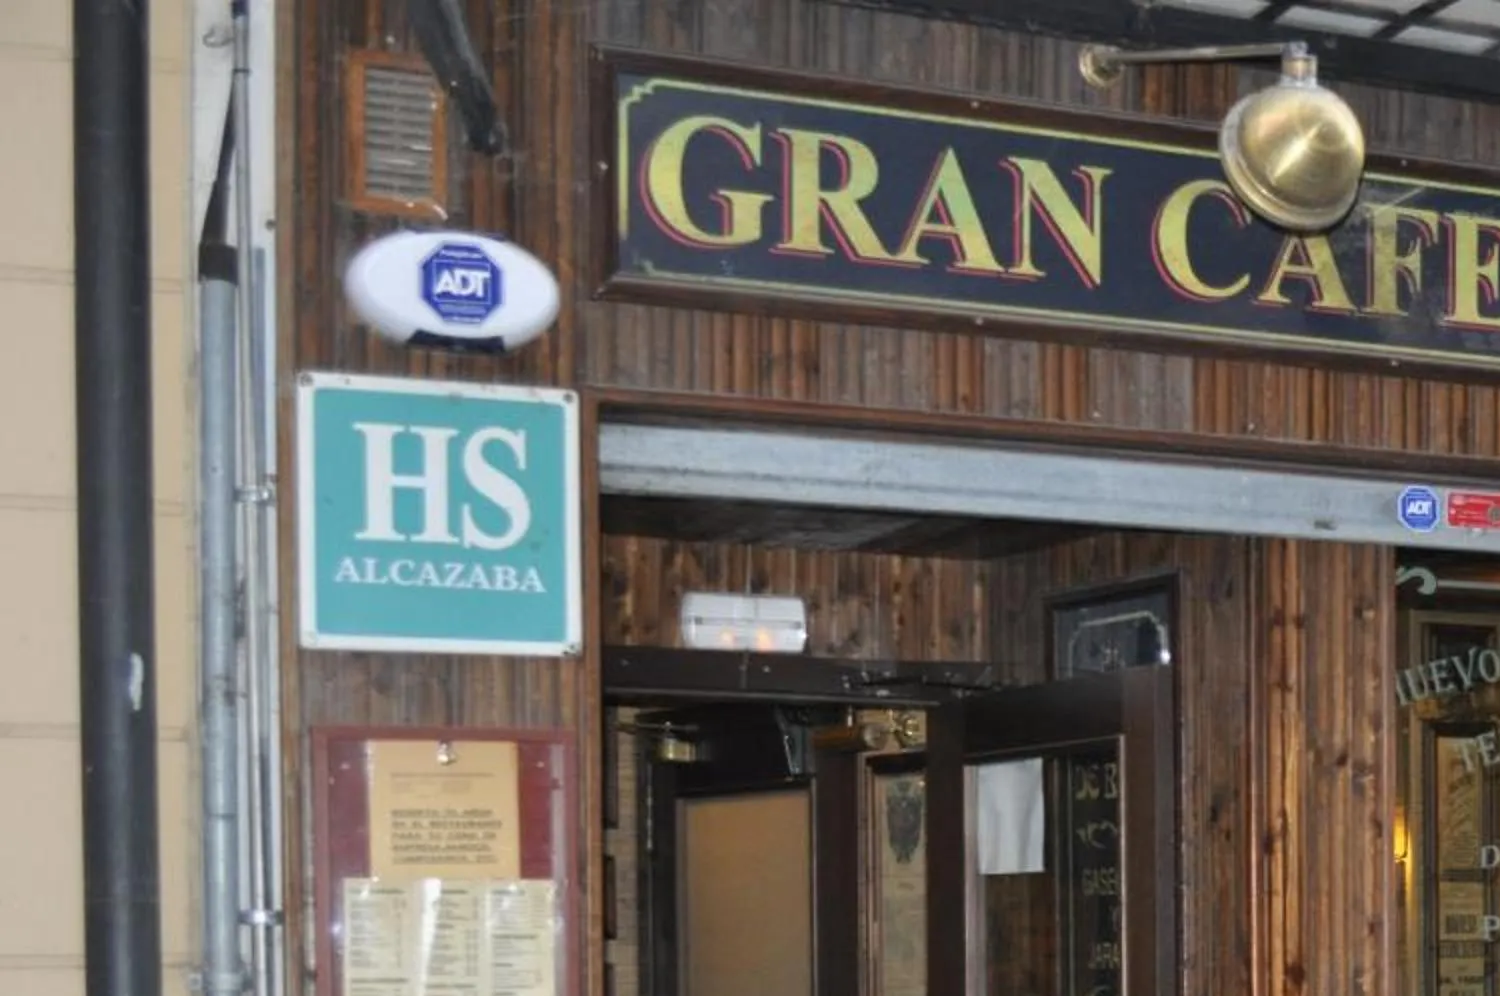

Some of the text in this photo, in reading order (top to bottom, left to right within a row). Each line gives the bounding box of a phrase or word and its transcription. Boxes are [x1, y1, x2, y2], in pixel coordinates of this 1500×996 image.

[640, 114, 1114, 289] GRAN
[435, 268, 491, 298] ADT
[352, 422, 531, 550] HS
[335, 556, 547, 593] ALCAZABA
